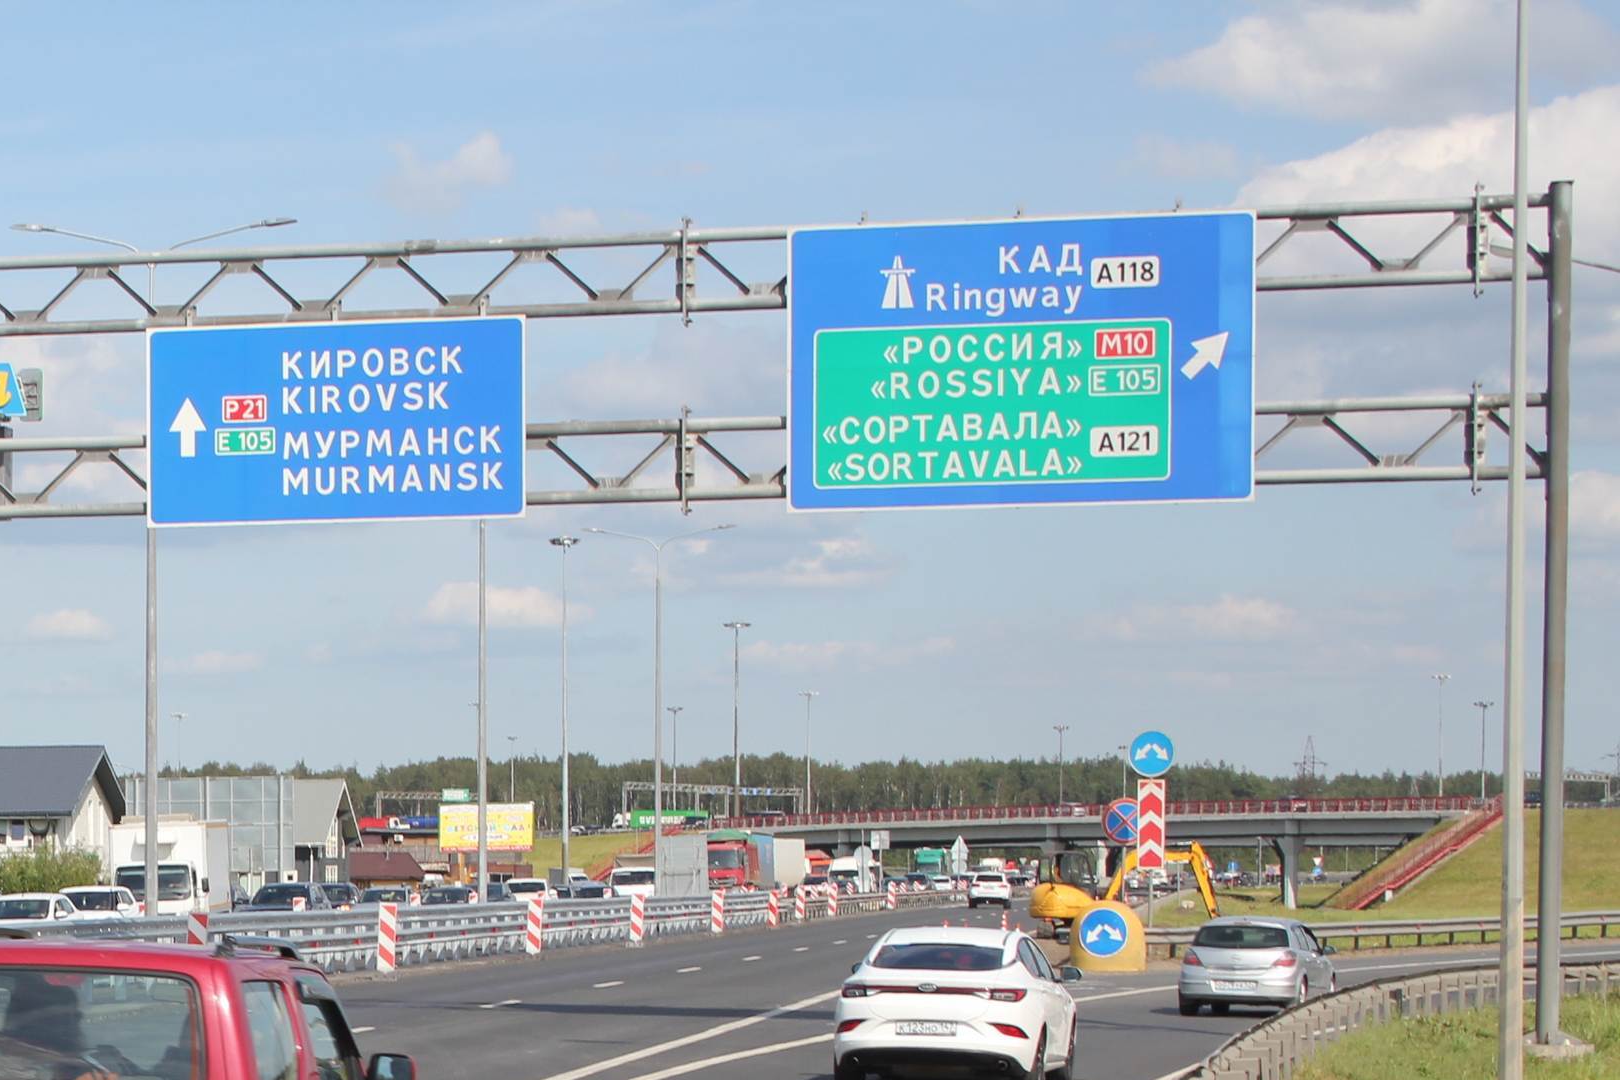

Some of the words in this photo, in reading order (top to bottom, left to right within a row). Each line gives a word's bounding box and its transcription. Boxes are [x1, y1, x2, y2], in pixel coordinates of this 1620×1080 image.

[998, 243, 1082, 277] КАД
[926, 281, 1082, 317] Ringway
[282, 345, 463, 380] КИРОВСК
[883, 332, 1082, 365] «РОССИЯ»
[282, 381, 449, 415] KIROVSK
[871, 368, 1082, 400] «ROSSIYA»
[283, 425, 502, 460] МУРМАНСК
[823, 411, 1082, 446] «СОРТАВАЛА»
[282, 462, 504, 496] MURMANSK
[828, 449, 1082, 481] «SORTAVALA»
